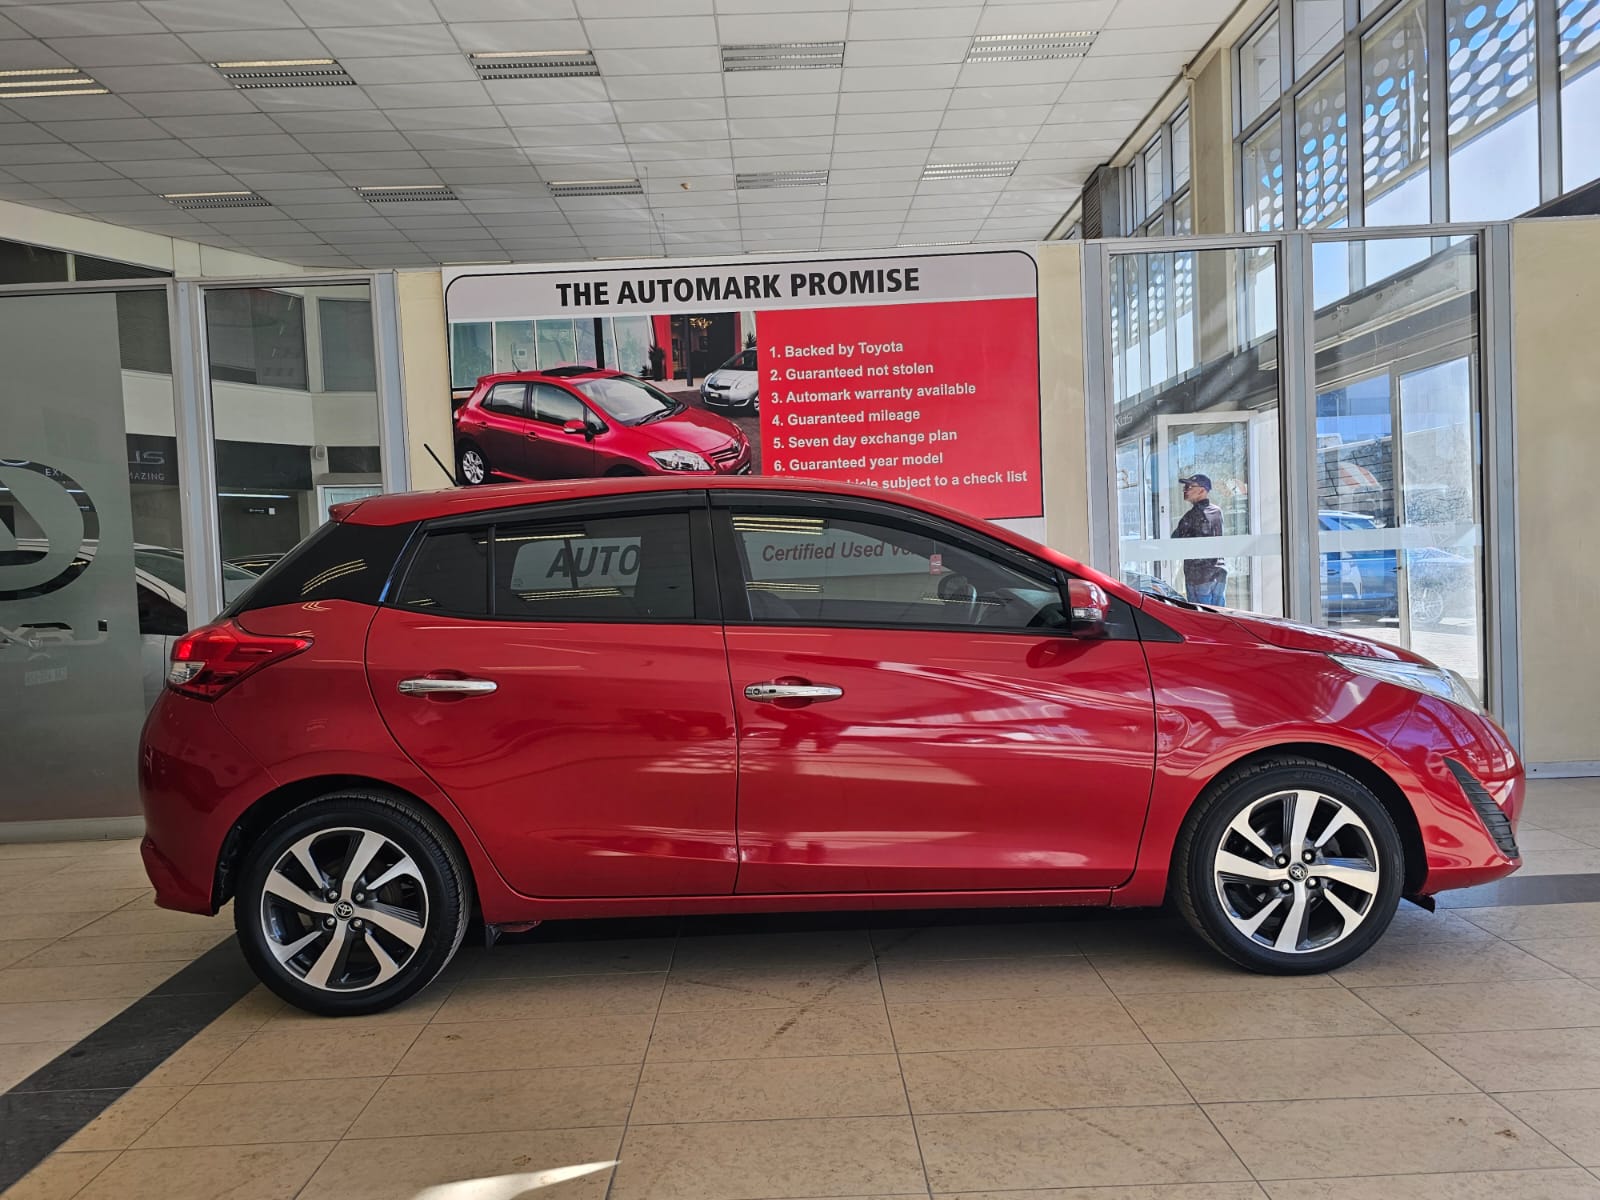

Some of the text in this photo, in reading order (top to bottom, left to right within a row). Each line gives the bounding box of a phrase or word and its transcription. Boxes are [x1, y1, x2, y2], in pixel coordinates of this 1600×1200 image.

[556, 267, 920, 307] THE AUTOMARK PROMISE
[769, 341, 904, 359] 1. Backed by Toyota
[770, 362, 934, 381] 2. Guaranteed not stolen
[771, 383, 977, 404] 3. Automark warranty available
[771, 409, 921, 427] 4. Guaranteed mileage
[773, 428, 958, 450] 5. Seven day exchange plan
[773, 451, 944, 472] 6. Guaranteed year model
[881, 475, 933, 491] subject
[934, 474, 949, 487] to
[951, 476, 960, 486] a
[962, 471, 1004, 486] check
[1006, 470, 1028, 483] list
[545, 543, 641, 578] AUTO
[762, 542, 836, 562] Certified
[841, 541, 885, 559] Used
